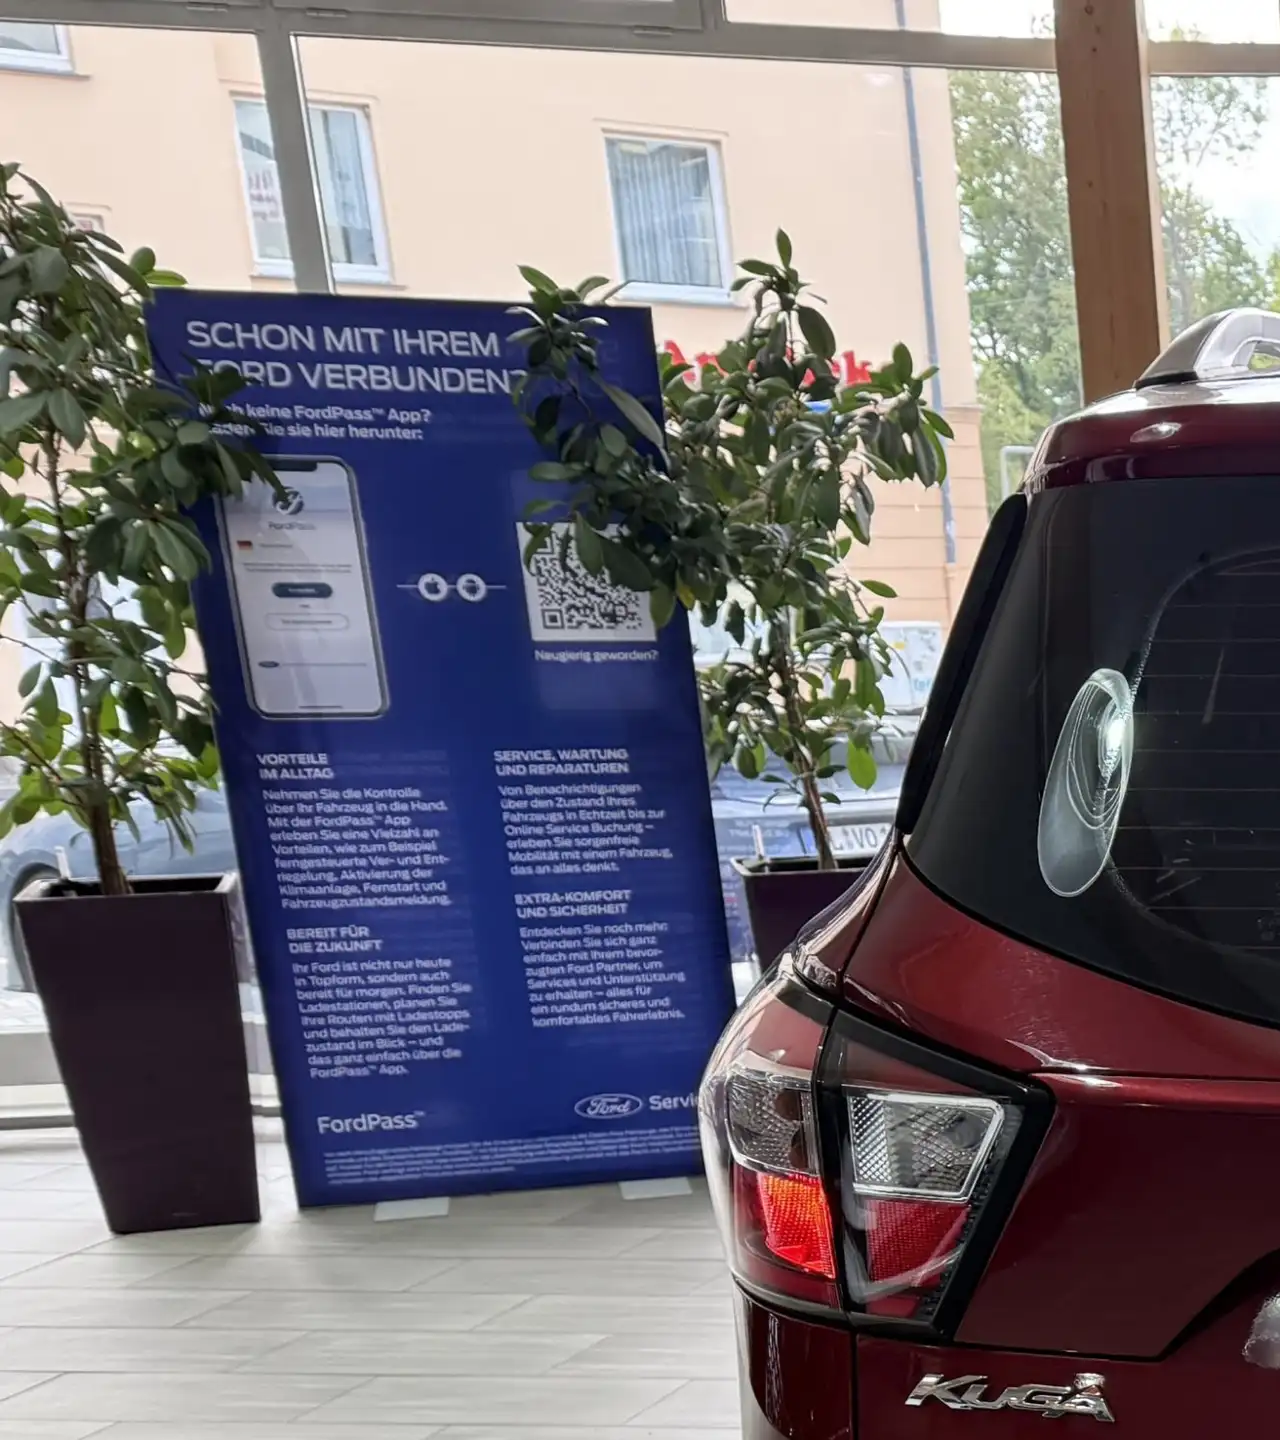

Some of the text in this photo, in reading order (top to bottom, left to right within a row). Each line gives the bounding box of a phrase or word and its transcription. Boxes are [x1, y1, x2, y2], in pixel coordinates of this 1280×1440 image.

[187, 320, 500, 357] SCHON MIT IHREM
[197, 359, 292, 388] ORD
[246, 403, 292, 419] keine
[388, 407, 431, 424] App?
[208, 422, 257, 437] aden
[286, 422, 313, 437] sie
[314, 423, 345, 438] hier
[348, 424, 424, 441] herunter:
[593, 650, 660, 663] geworden?
[257, 754, 328, 764] VORTEILE
[494, 749, 628, 762] SERVICE, WARTUNG
[259, 768, 334, 779] IM ALLTAG
[496, 762, 629, 776] UND REPARATUREN
[262, 788, 420, 800] Nehmen Sie die Kontrolle
[498, 783, 641, 795] Von Benachrichtigungen
[265, 803, 294, 814] über
[297, 803, 313, 813] Ihr
[316, 802, 374, 813] Fahrzeug
[376, 802, 388, 811] in
[390, 801, 408, 811] die
[501, 796, 636, 809] über den Zustand Ihres
[268, 817, 288, 827] Mit
[291, 816, 311, 826] der
[385, 815, 411, 826] App
[503, 808, 665, 823] Fahrzeugs in Echtzeit bis zur
[270, 829, 438, 841] erleben Sie eine Vielzahl an
[504, 822, 643, 835] Online Service Buchung
[506, 835, 639, 848] erleben Sie sorgenfreie
[275, 858, 368, 869] ferngesteuerte
[397, 855, 421, 865] und
[508, 851, 559, 862] Mobilität
[562, 850, 580, 860] mit
[583, 849, 617, 858] einem
[341, 869, 409, 881] Aktivierung
[412, 869, 432, 878] der
[510, 864, 532, 875] das
[536, 865, 550, 874] an
[553, 863, 580, 873] alles
[364, 883, 420, 893] Fernstart
[423, 882, 446, 891] und
[515, 890, 631, 904] EXTRA-KOMFORT
[517, 903, 628, 918] UND SICHERHEIT
[287, 925, 369, 939] BEREIT FÜR
[520, 926, 581, 938] Entdecken
[584, 924, 601, 934] Sie
[604, 923, 632, 933] noch
[289, 940, 382, 953] DIE ZUKUNFT
[521, 936, 656, 950] Verbinden Sie sich ganz
[292, 958, 451, 973] Ihr Ford ist nicht nur heute
[295, 977, 306, 986] in
[368, 972, 417, 983] sondern
[420, 971, 449, 981] auch
[394, 999, 435, 1009] planen
[437, 997, 458, 1006] Sie
[301, 1010, 470, 1025] Ihre Routen mit Ladestopps
[533, 1015, 610, 1028] komfortables
[304, 1029, 327, 1039] und
[330, 1026, 384, 1037] behalten
[387, 1026, 406, 1035] Sie
[408, 1024, 431, 1034] den
[584, 1092, 700, 1116] Ford Servi
